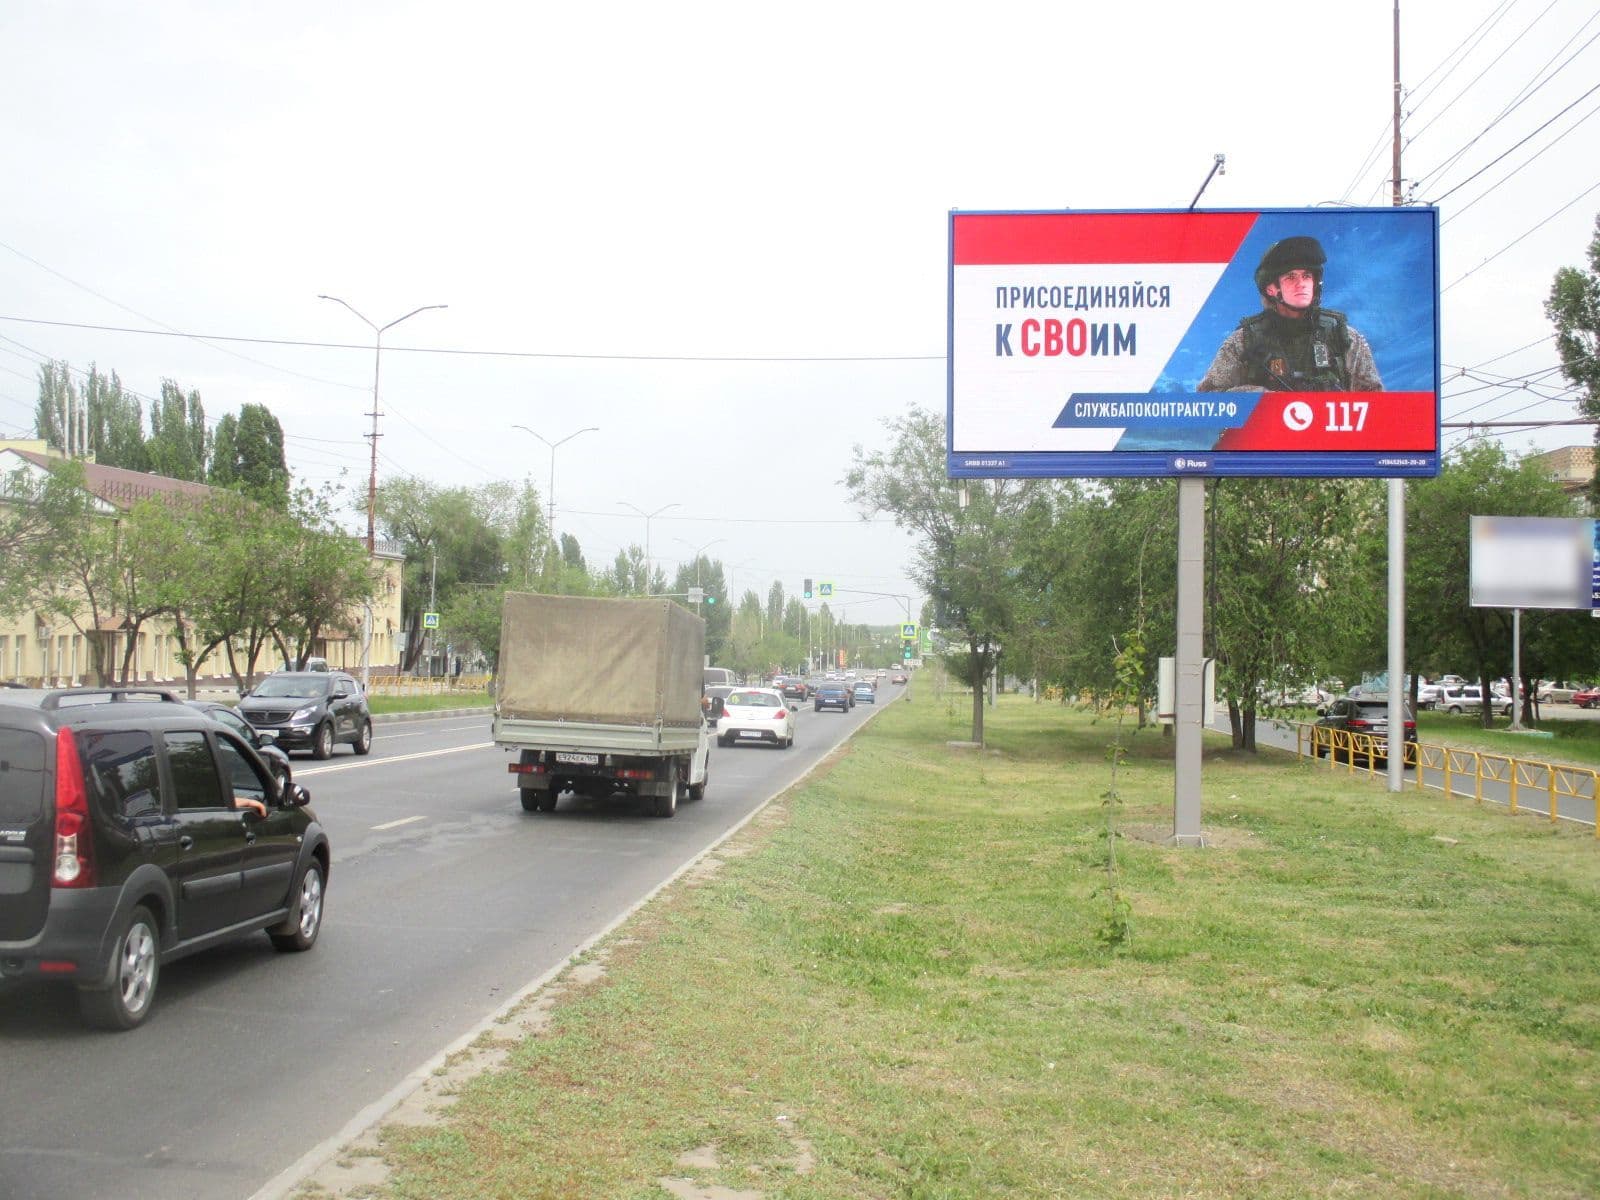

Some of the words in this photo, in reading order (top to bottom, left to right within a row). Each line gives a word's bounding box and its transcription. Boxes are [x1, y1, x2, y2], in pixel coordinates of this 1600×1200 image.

[996, 281, 1171, 311] ПРИСОЕДИНЯЙСЯ
[996, 323, 1013, 356] К
[1074, 402, 1238, 418] СЛУЖБАПОКОНТРАКТУ.РФ
[1325, 401, 1369, 432] 117
